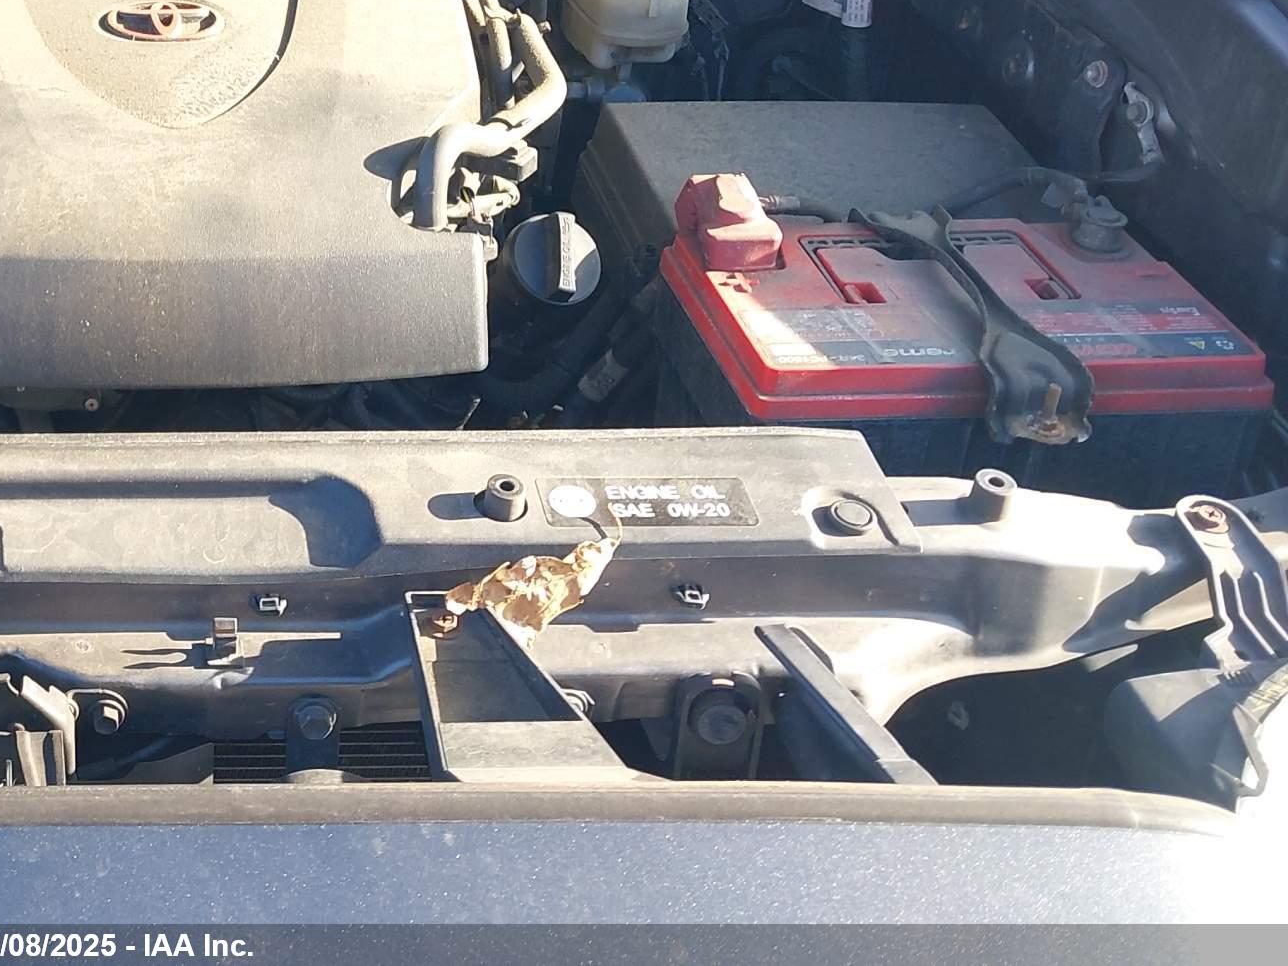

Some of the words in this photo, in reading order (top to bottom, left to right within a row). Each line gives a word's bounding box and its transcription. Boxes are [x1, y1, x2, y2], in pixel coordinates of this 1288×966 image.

[605, 484, 681, 500] ENGINE
[691, 485, 726, 500] OIL
[613, 502, 656, 518] SAE
[667, 503, 730, 518] 0W-20
